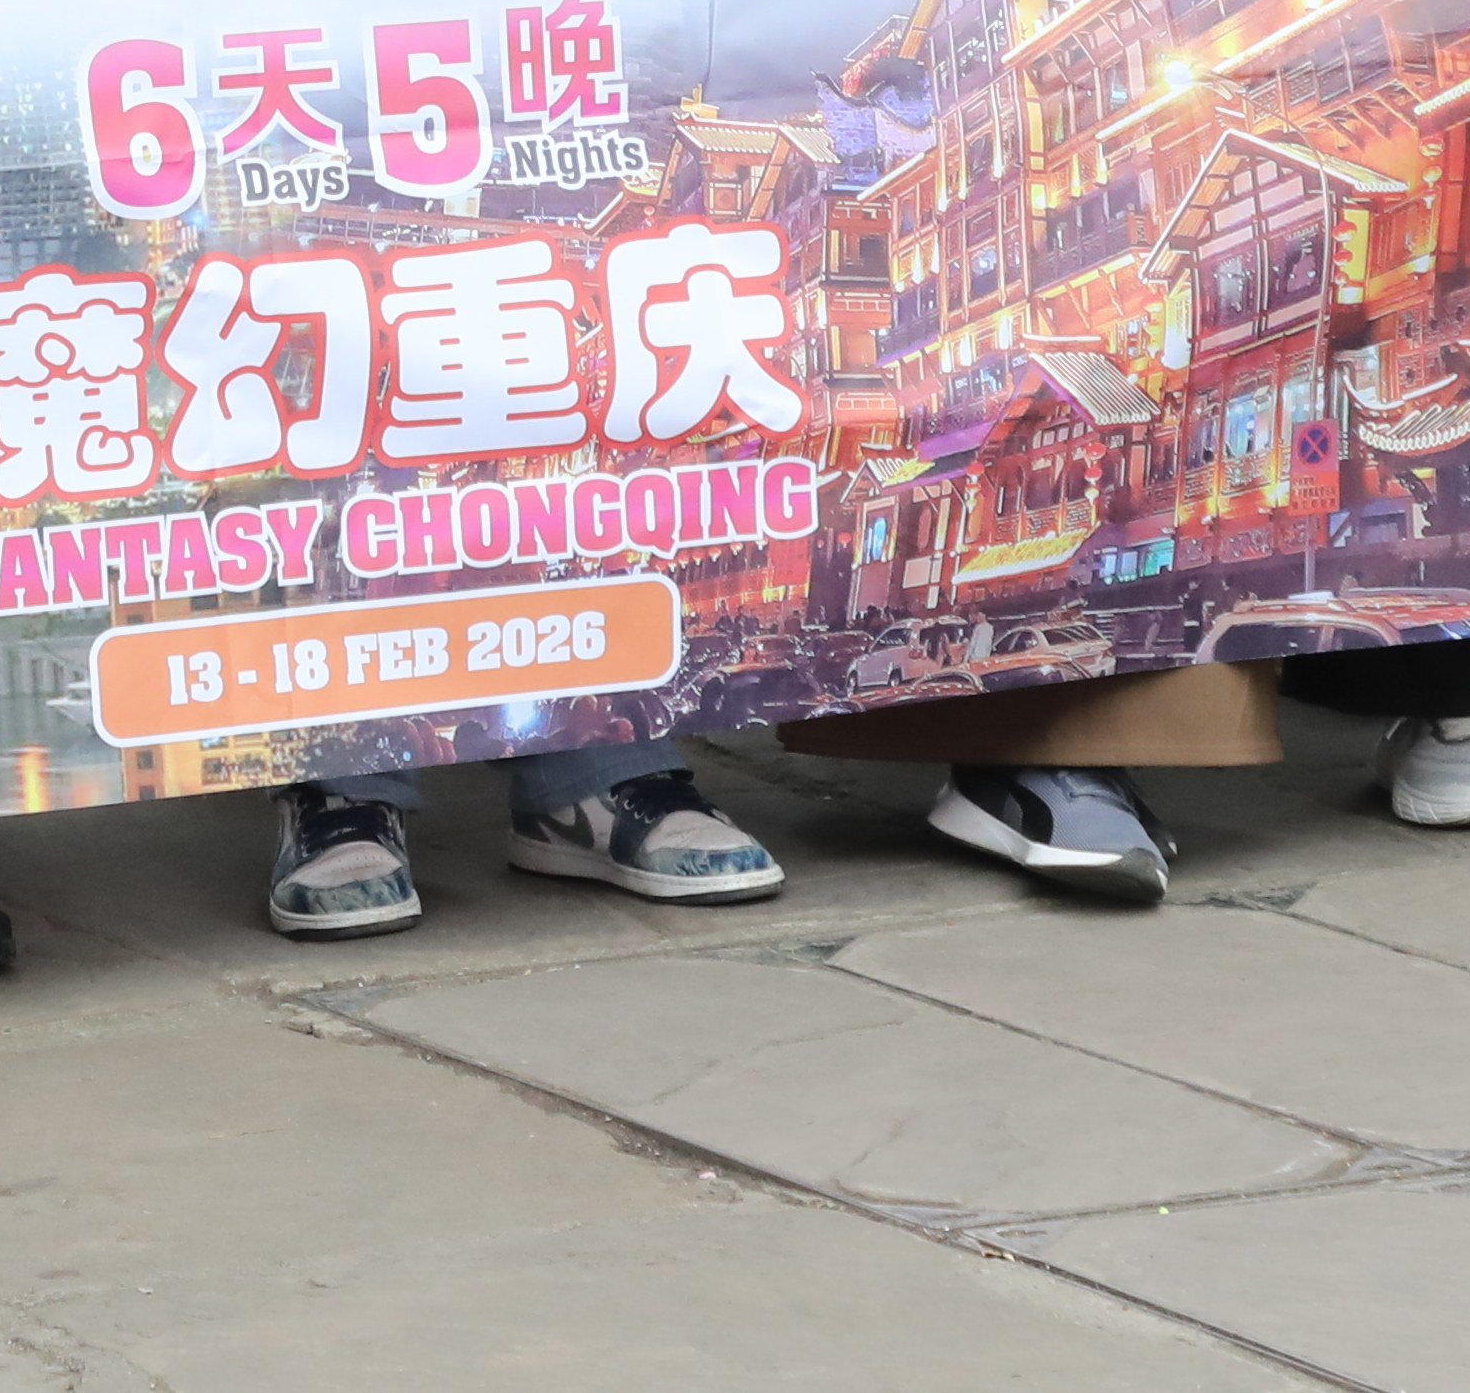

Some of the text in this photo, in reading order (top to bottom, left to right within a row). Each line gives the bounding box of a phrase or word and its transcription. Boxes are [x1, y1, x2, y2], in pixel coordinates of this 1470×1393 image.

[245, 137, 646, 210] Days Nights
[344, 459, 818, 579] CHONGQING
[167, 650, 223, 705] 13
[273, 638, 329, 694] 18
[345, 627, 450, 685] FEB
[466, 611, 607, 671] 2026
